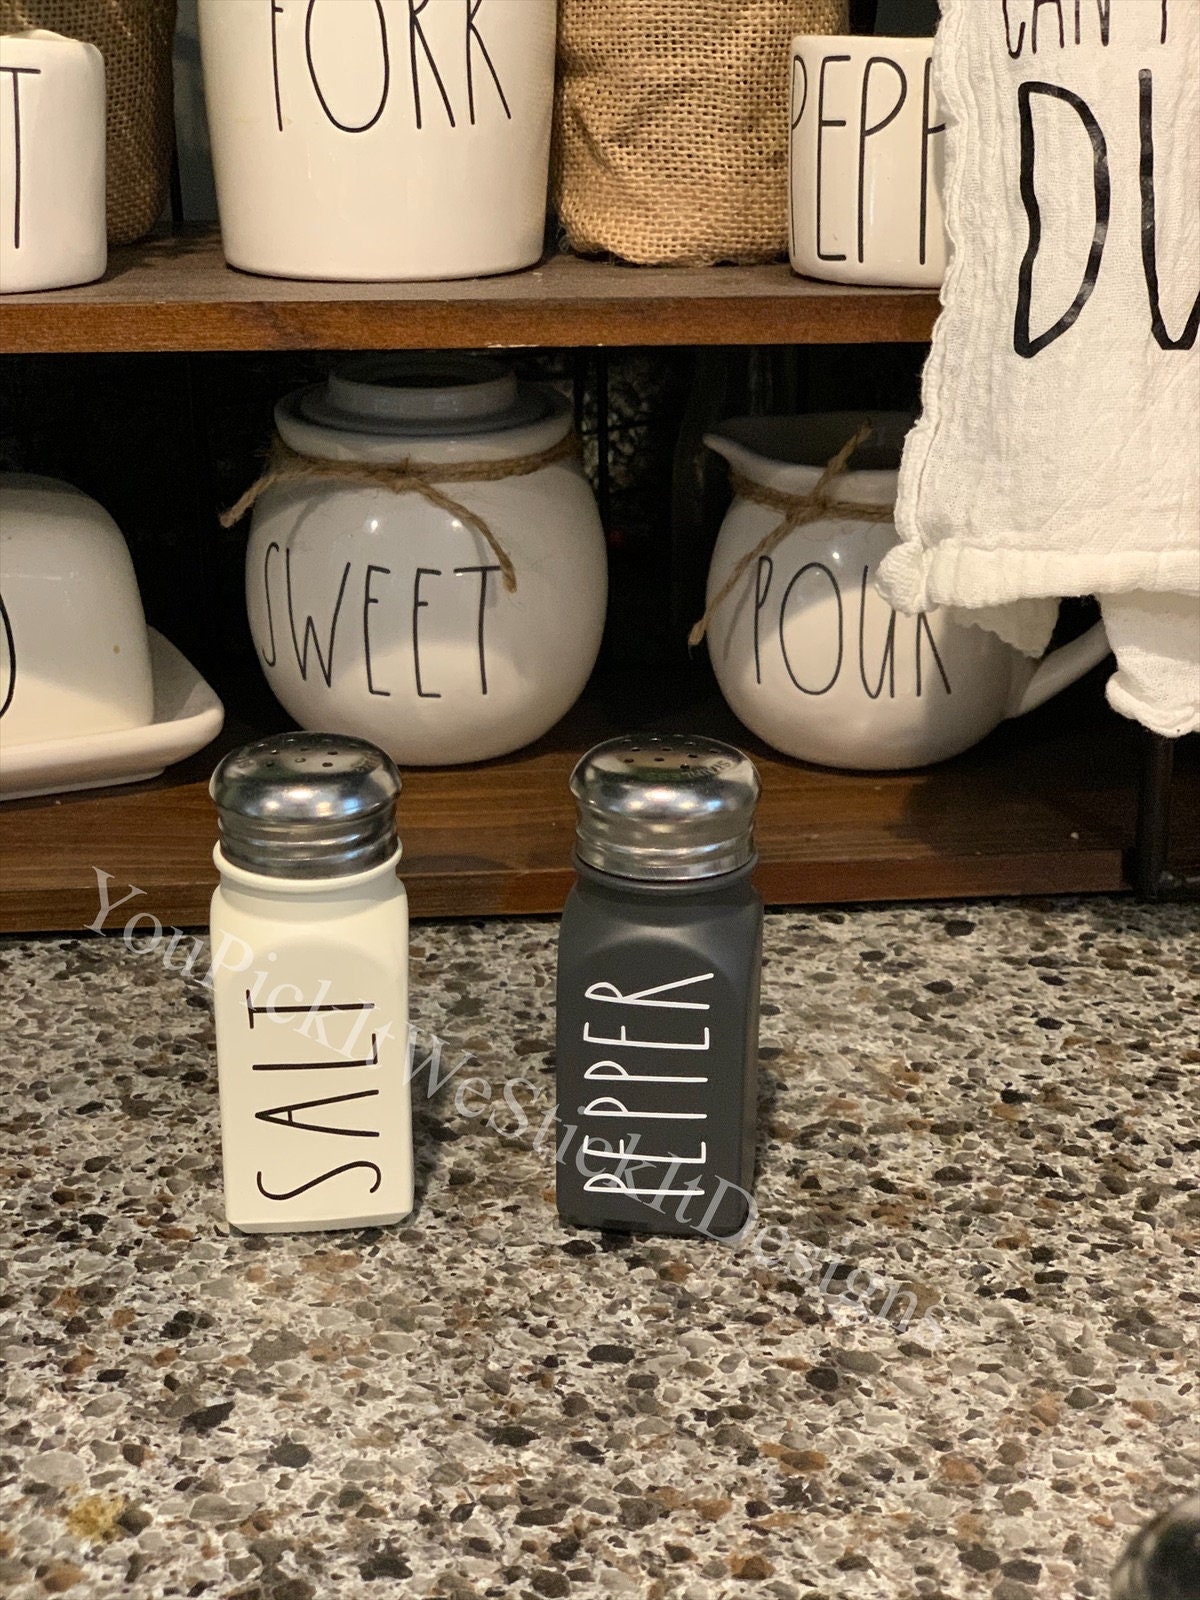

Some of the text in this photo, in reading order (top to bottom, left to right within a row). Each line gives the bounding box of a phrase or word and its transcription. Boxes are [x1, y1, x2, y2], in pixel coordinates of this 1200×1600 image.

[271, 0, 512, 133] FORK
[261, 541, 502, 699] SWEET
[245, 988, 382, 1201] SALT
[582, 972, 715, 1196] PEPPER
